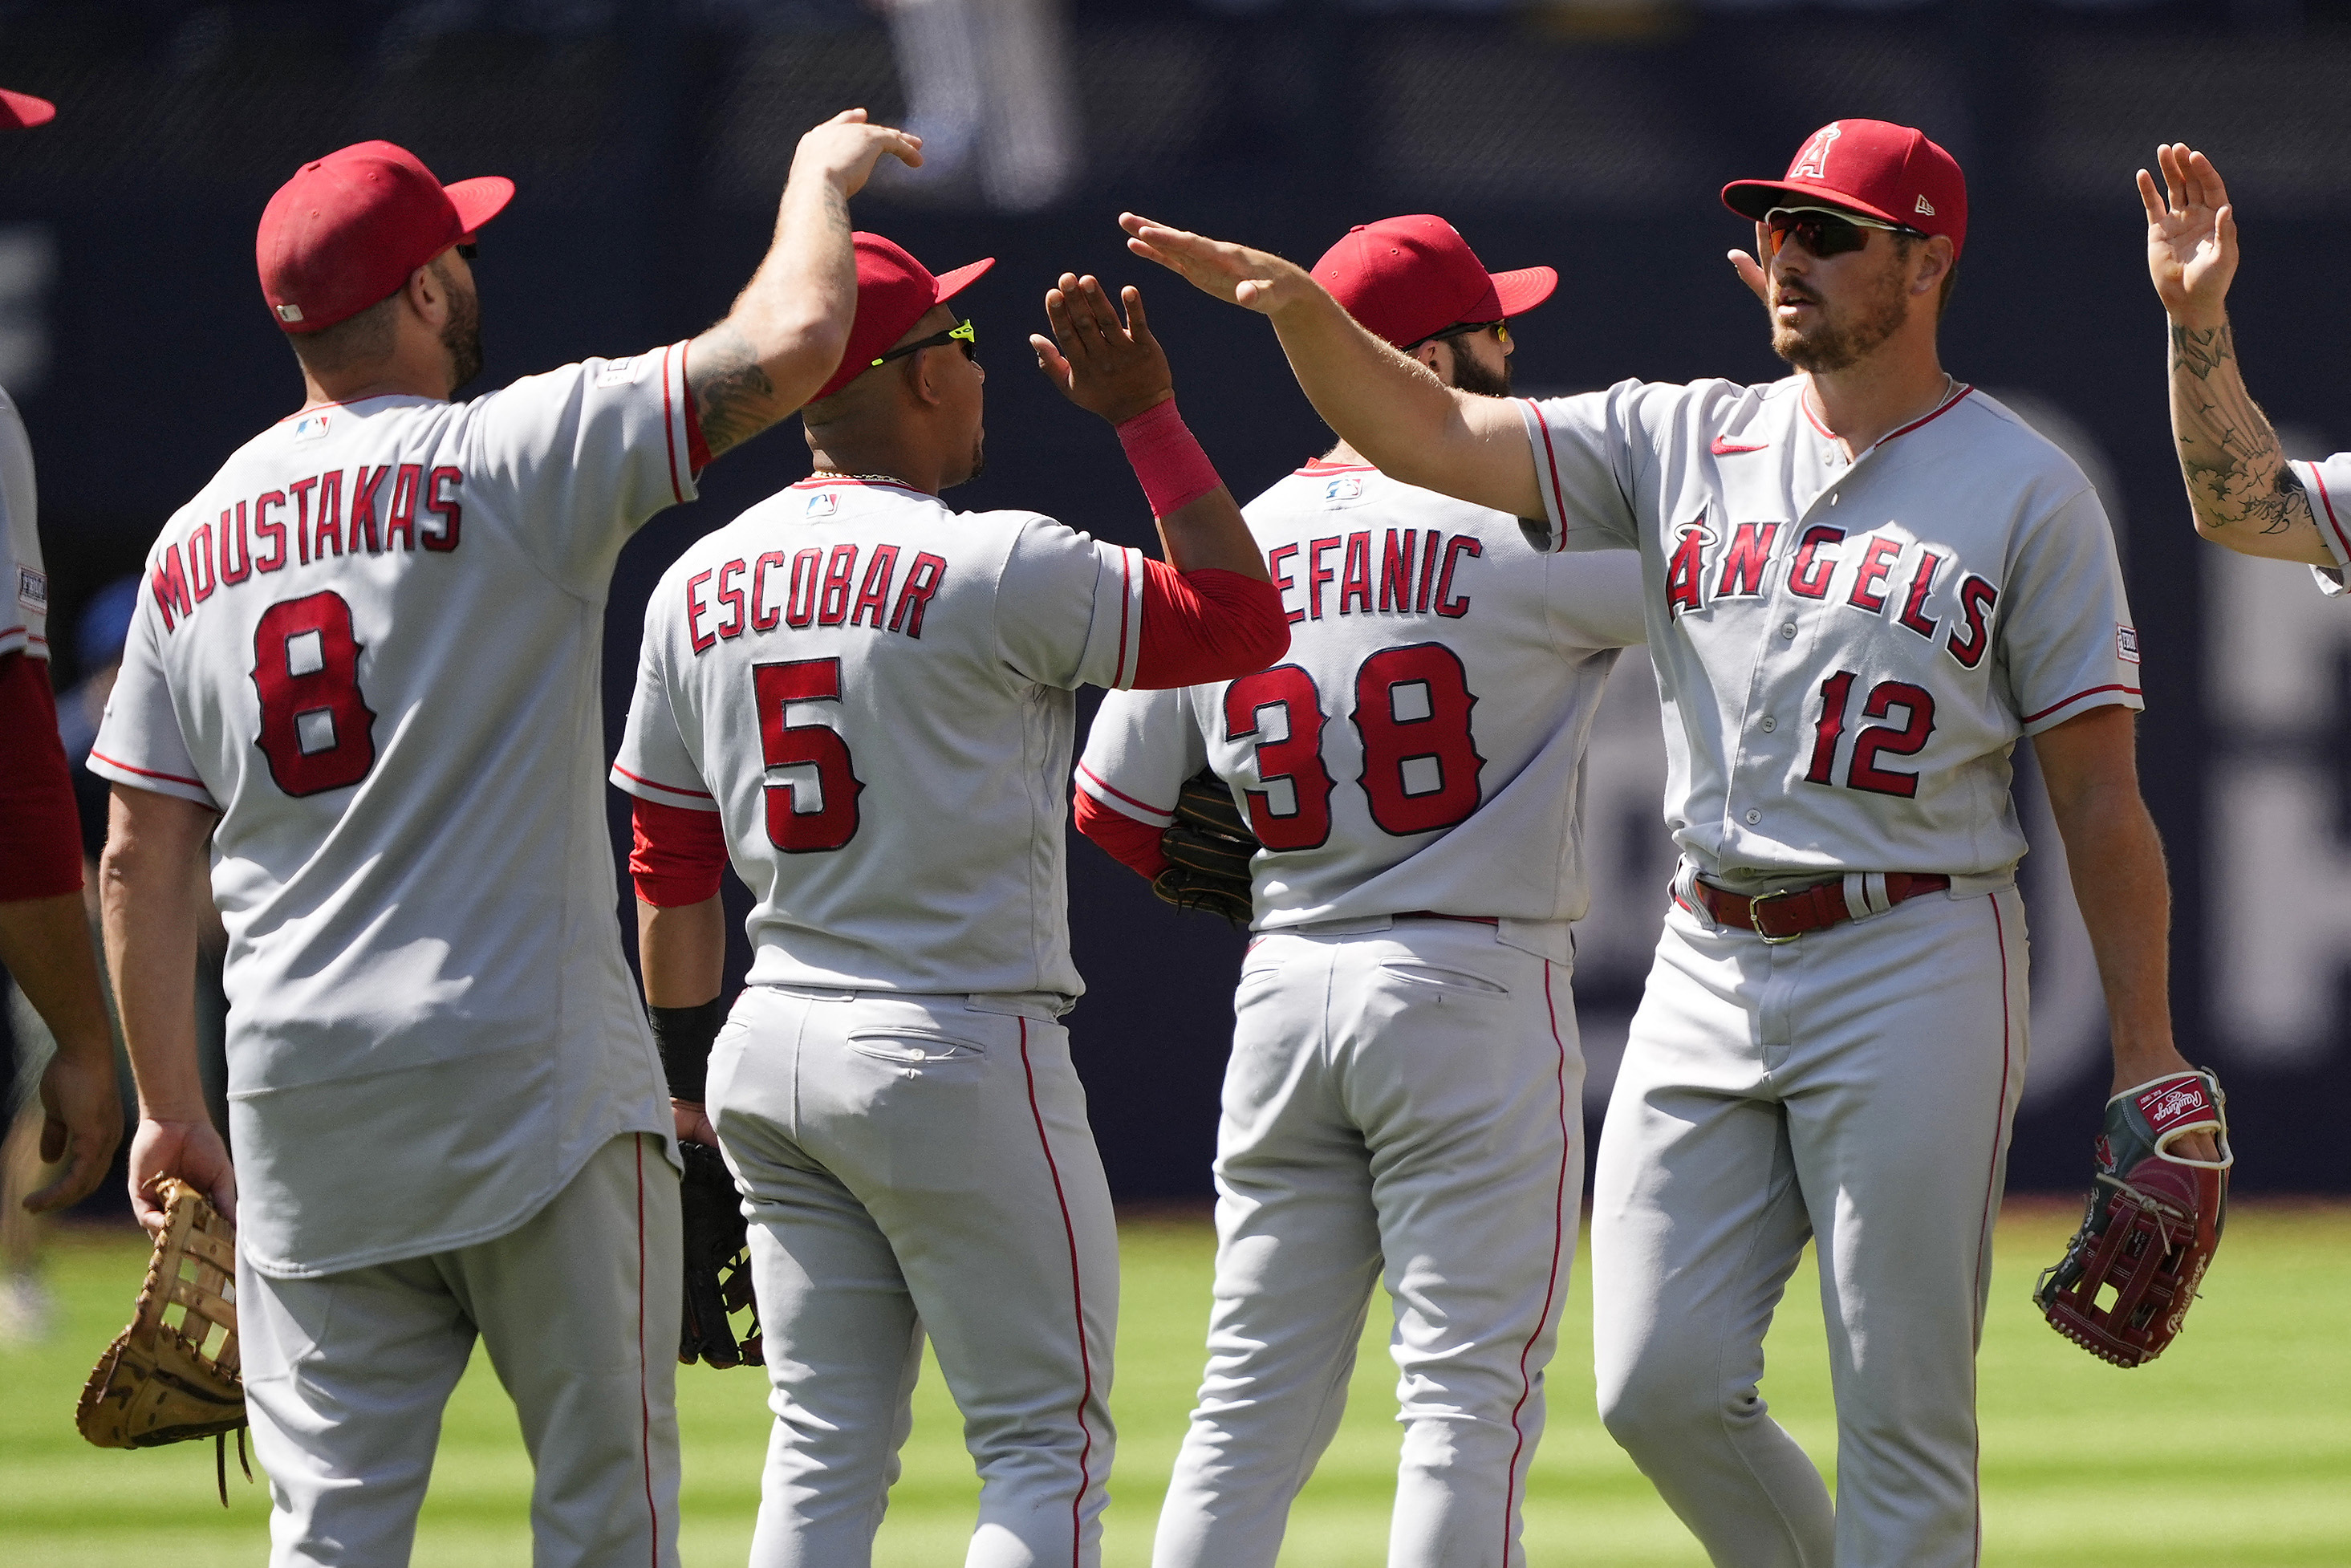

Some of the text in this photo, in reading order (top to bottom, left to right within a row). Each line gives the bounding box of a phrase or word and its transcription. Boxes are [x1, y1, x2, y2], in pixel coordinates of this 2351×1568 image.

[151, 463, 464, 633] MOUSTAKAS
[686, 542, 947, 656] ESCOBAR
[1269, 527, 1484, 624] EFANIC
[1665, 494, 2002, 672] ANGELS
[249, 589, 378, 798] 8
[752, 656, 867, 854] 5
[1223, 640, 1488, 852] 38
[1803, 668, 1937, 799] 12
[2153, 1090, 2203, 1121] Rawlings
